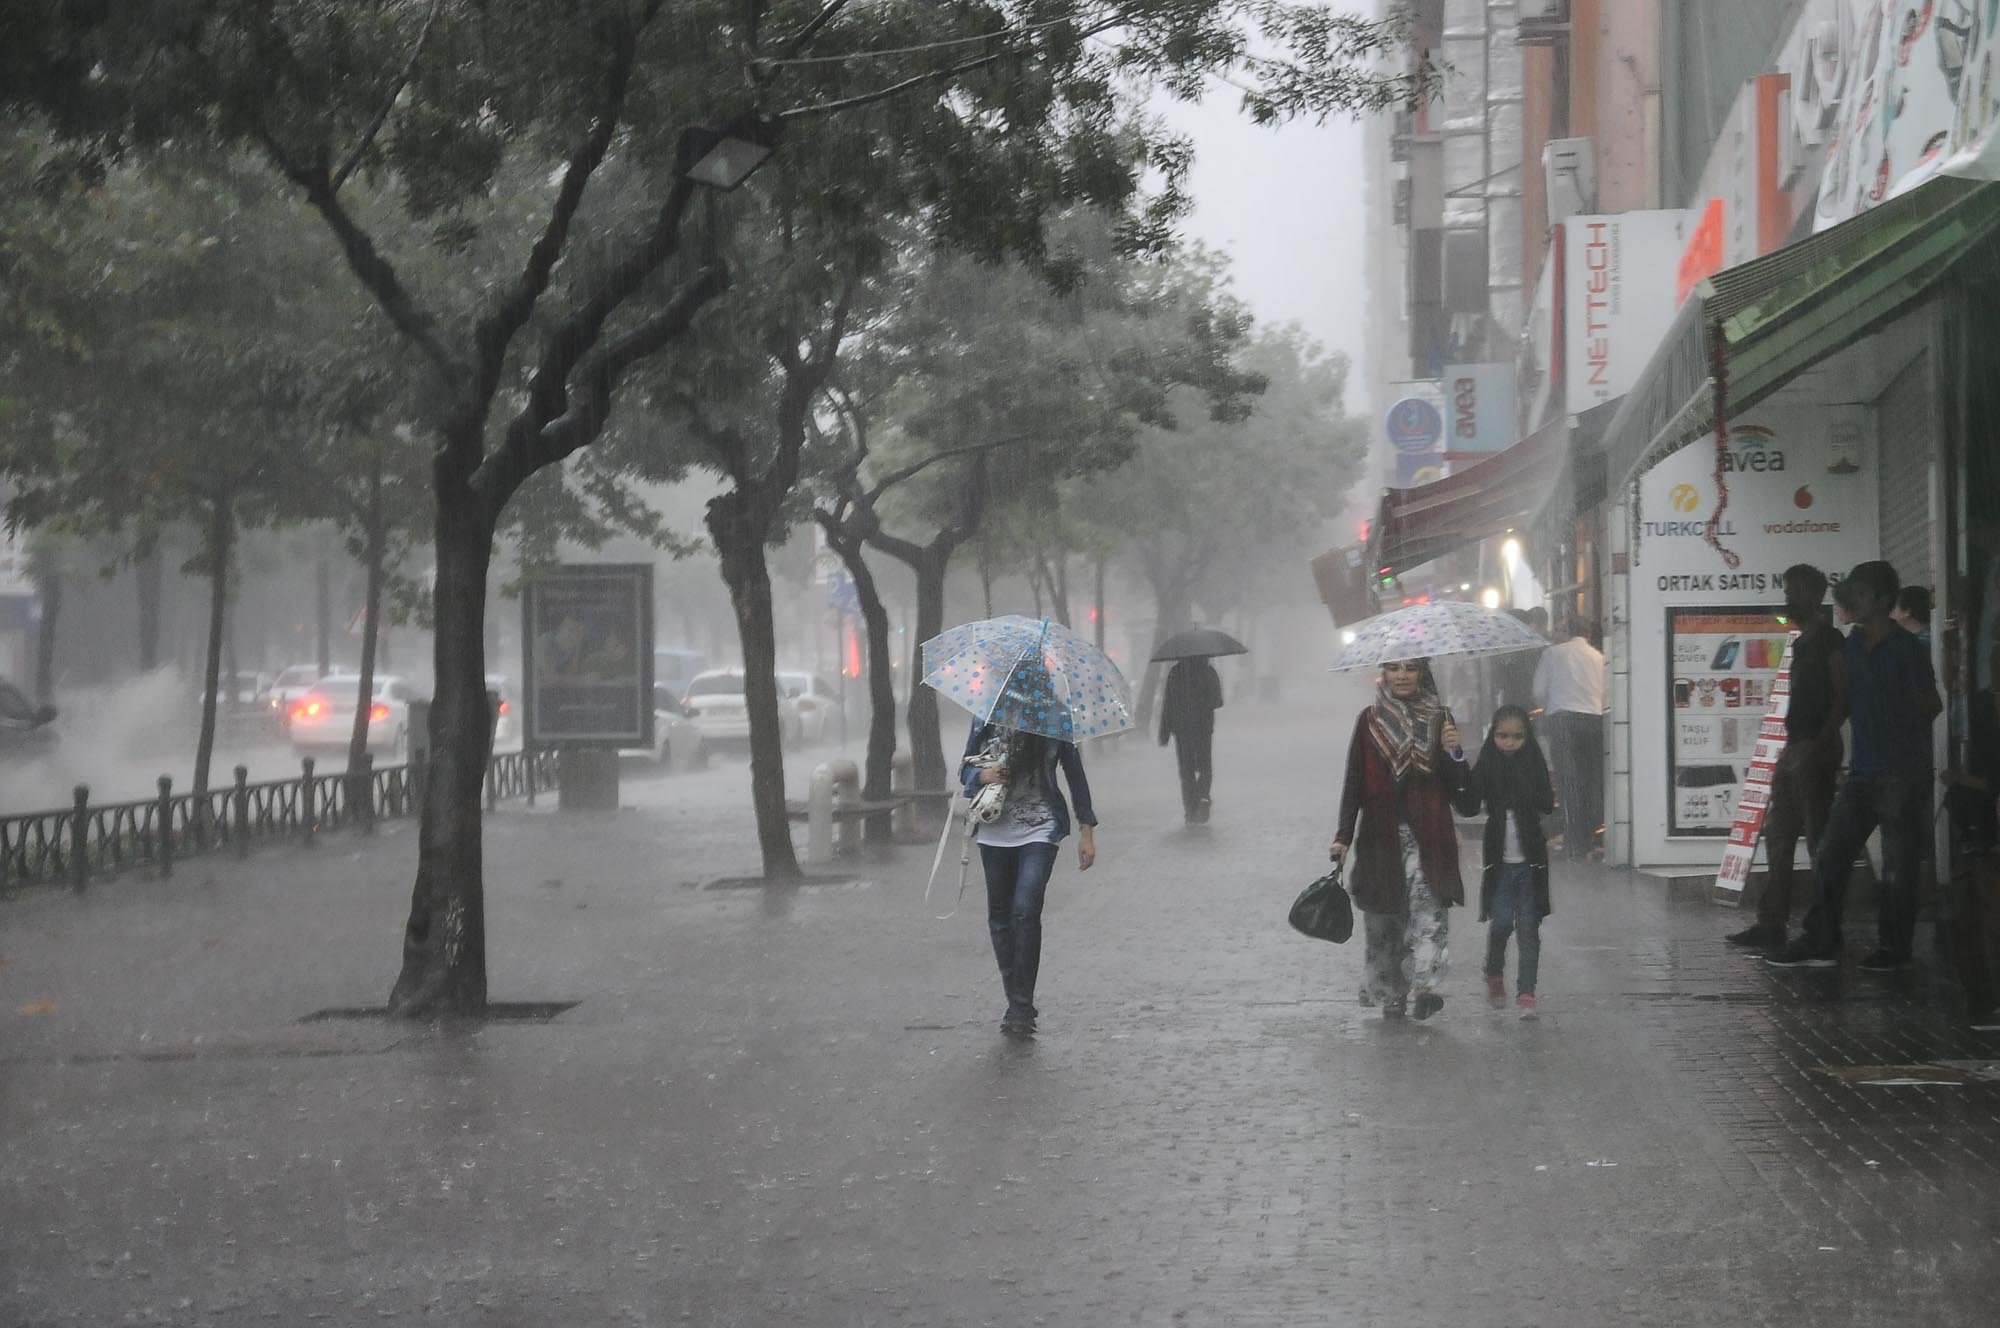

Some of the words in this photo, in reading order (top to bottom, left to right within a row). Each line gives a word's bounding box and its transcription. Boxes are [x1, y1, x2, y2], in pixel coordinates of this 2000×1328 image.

[1586, 223, 1609, 386] NETTECH
[1455, 377, 1476, 439] avea
[1722, 450, 1785, 472] avea
[1644, 520, 1738, 536] TURKCLL
[1762, 519, 1841, 534] vodafone
[1657, 574, 1714, 592] ORTAK
[1719, 573, 1767, 594] SATIŞ
[1678, 645, 1701, 653] FLIP
